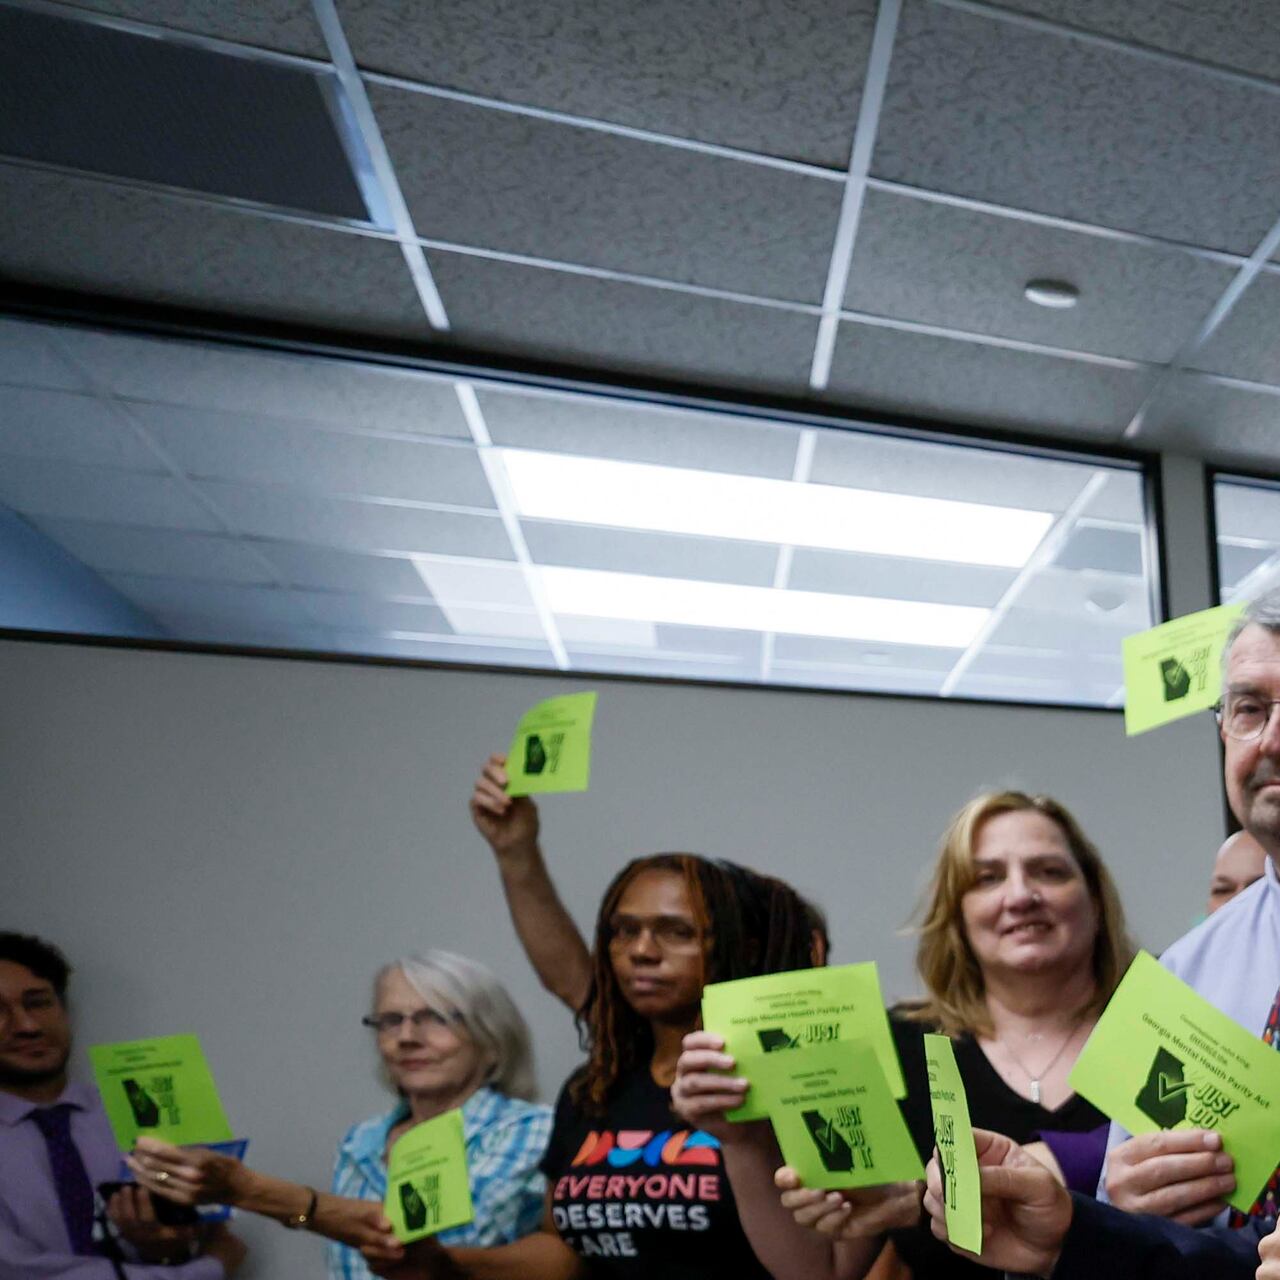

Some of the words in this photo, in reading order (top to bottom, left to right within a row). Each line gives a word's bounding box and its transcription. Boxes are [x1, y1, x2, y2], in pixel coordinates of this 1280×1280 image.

[803, 1022, 840, 1043] JUST
[1141, 1012, 1172, 1039] Georgia
[1171, 1034, 1199, 1061] Mental
[1199, 1054, 1227, 1080] Health
[1227, 1075, 1254, 1098] Parity
[1254, 1093, 1271, 1109] Act
[1193, 1081, 1240, 1119] JUST
[836, 1105, 862, 1127] JUST
[553, 1173, 722, 1201] EVERYONE
[553, 1202, 711, 1231] DESERVES
[566, 1231, 638, 1258] ARE
